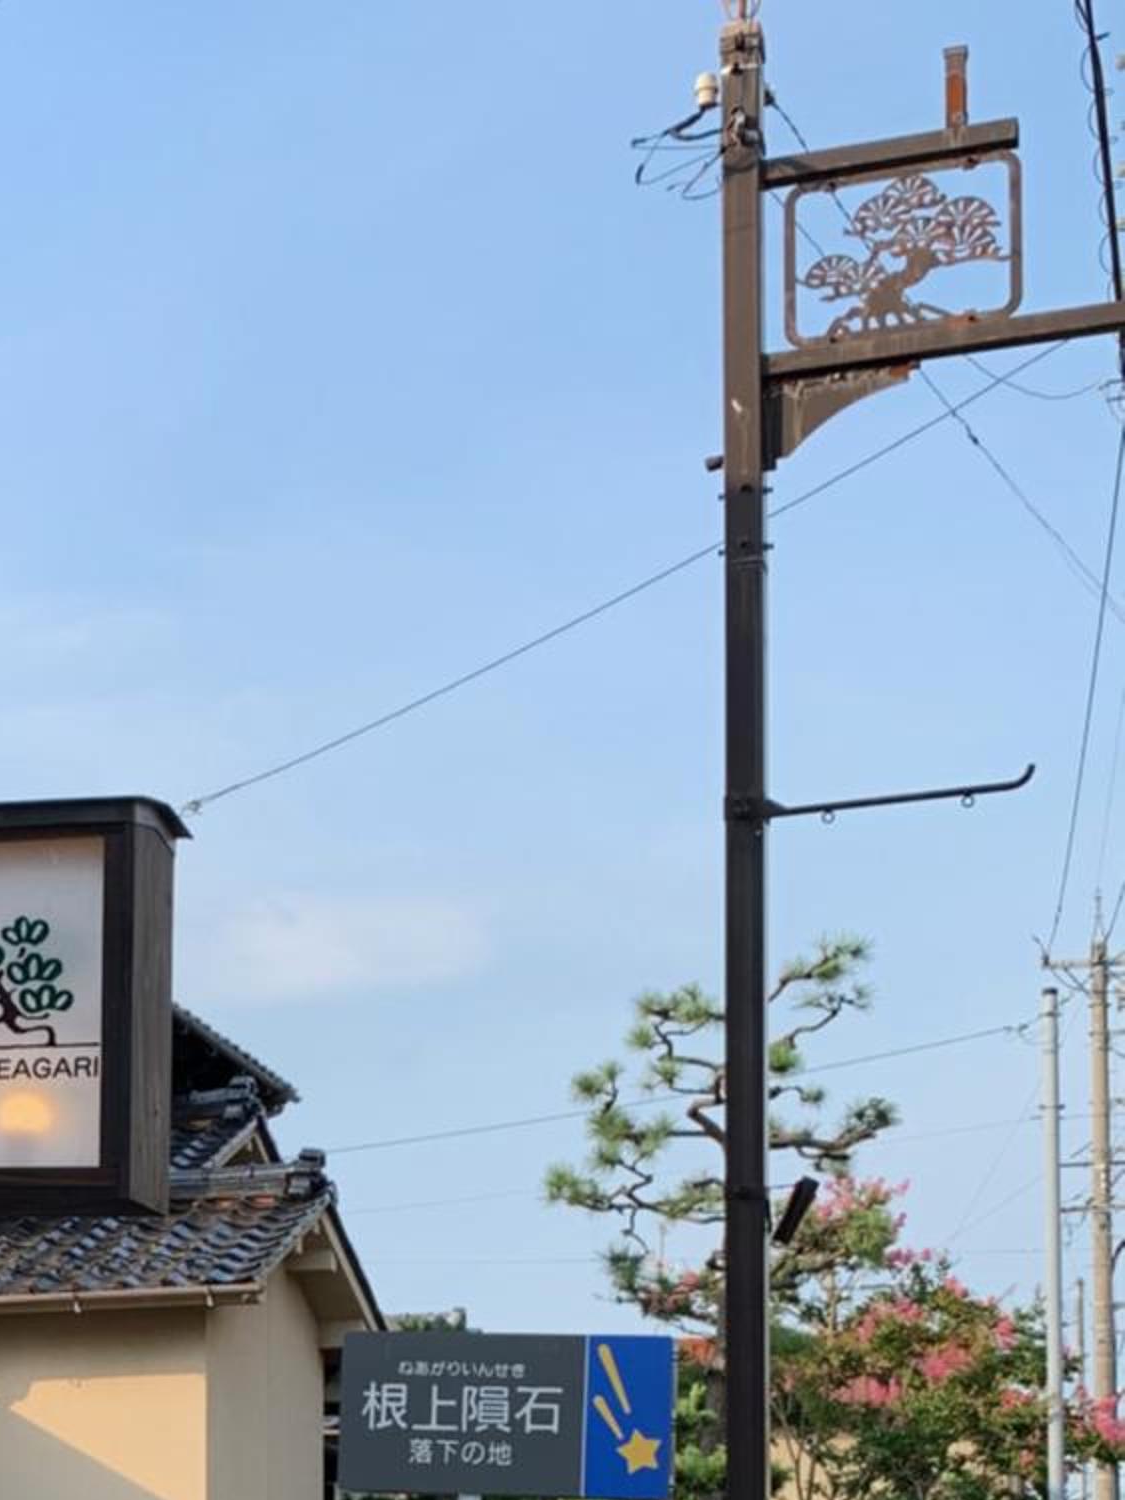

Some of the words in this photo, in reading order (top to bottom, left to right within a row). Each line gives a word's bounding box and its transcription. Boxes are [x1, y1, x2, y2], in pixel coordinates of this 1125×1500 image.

[361, 1380, 564, 1434] 根上隕石
[408, 1438, 513, 1467] 落下の地
